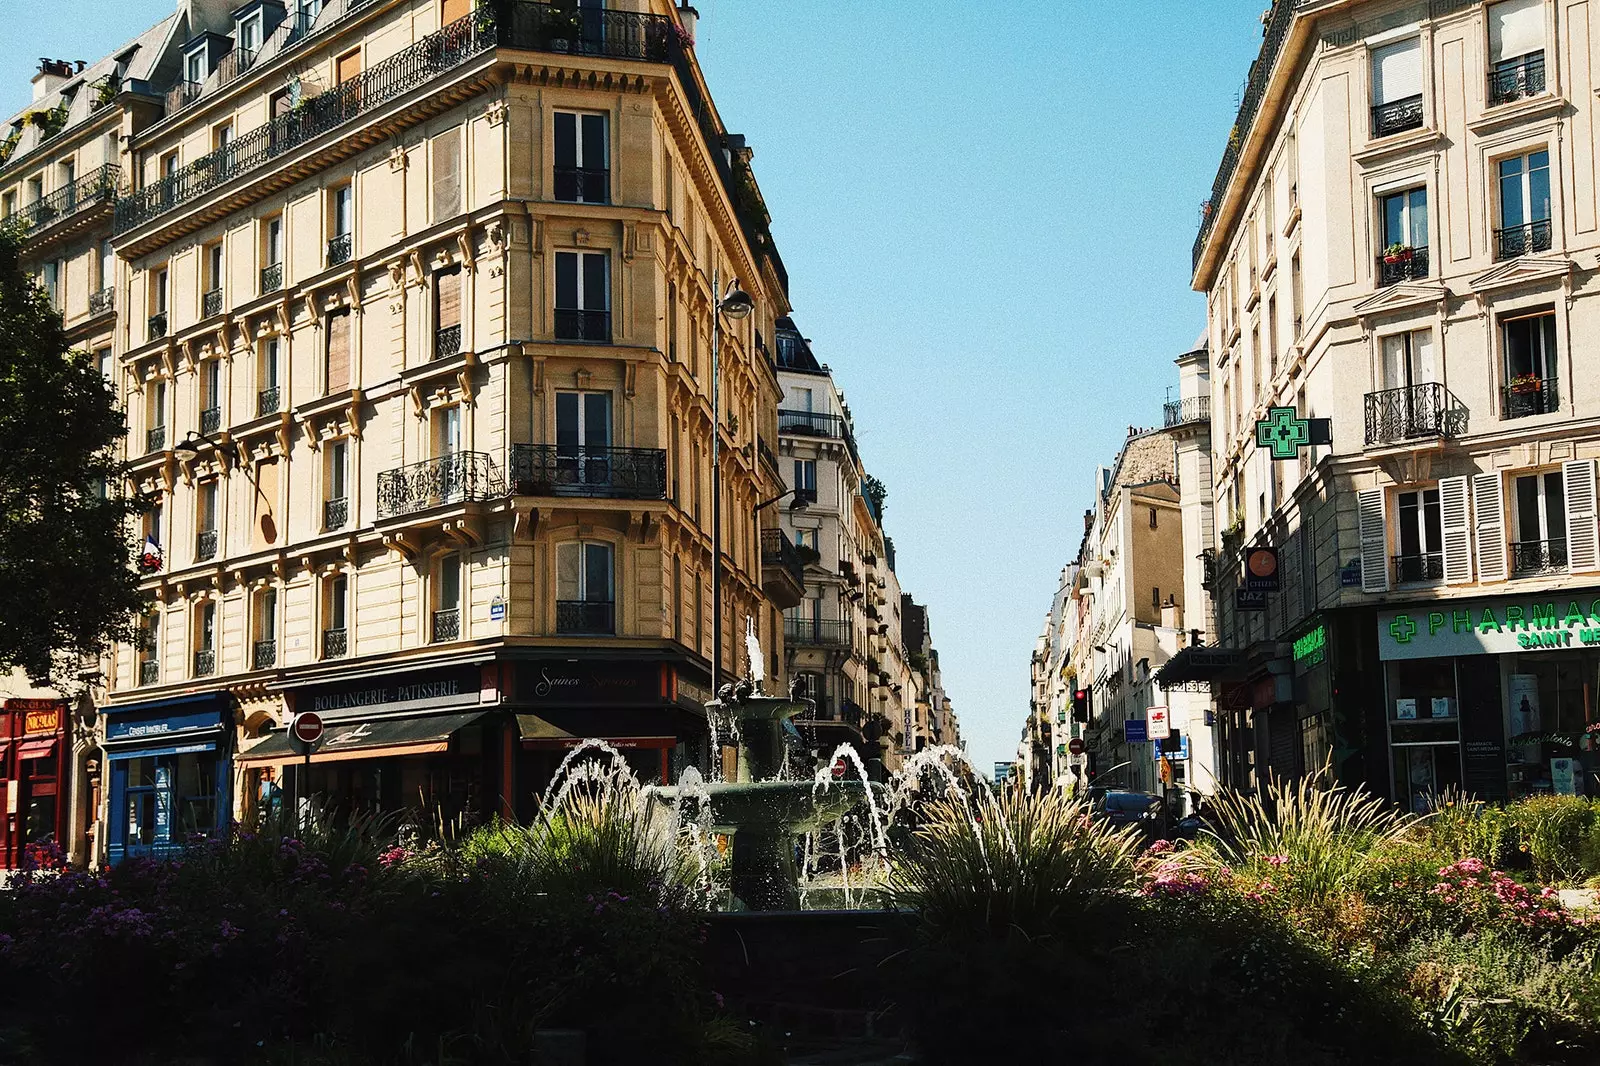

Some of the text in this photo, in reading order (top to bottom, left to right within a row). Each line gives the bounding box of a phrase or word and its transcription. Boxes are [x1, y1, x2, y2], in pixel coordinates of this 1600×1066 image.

[1240, 592, 1264, 601] JAZ
[1517, 630, 1569, 646] SAINT
[535, 667, 580, 697] Saines
[314, 689, 388, 711] BOULANGERIE
[398, 680, 459, 701] PATISSERIE
[28, 713, 56, 730] NICOLAS
